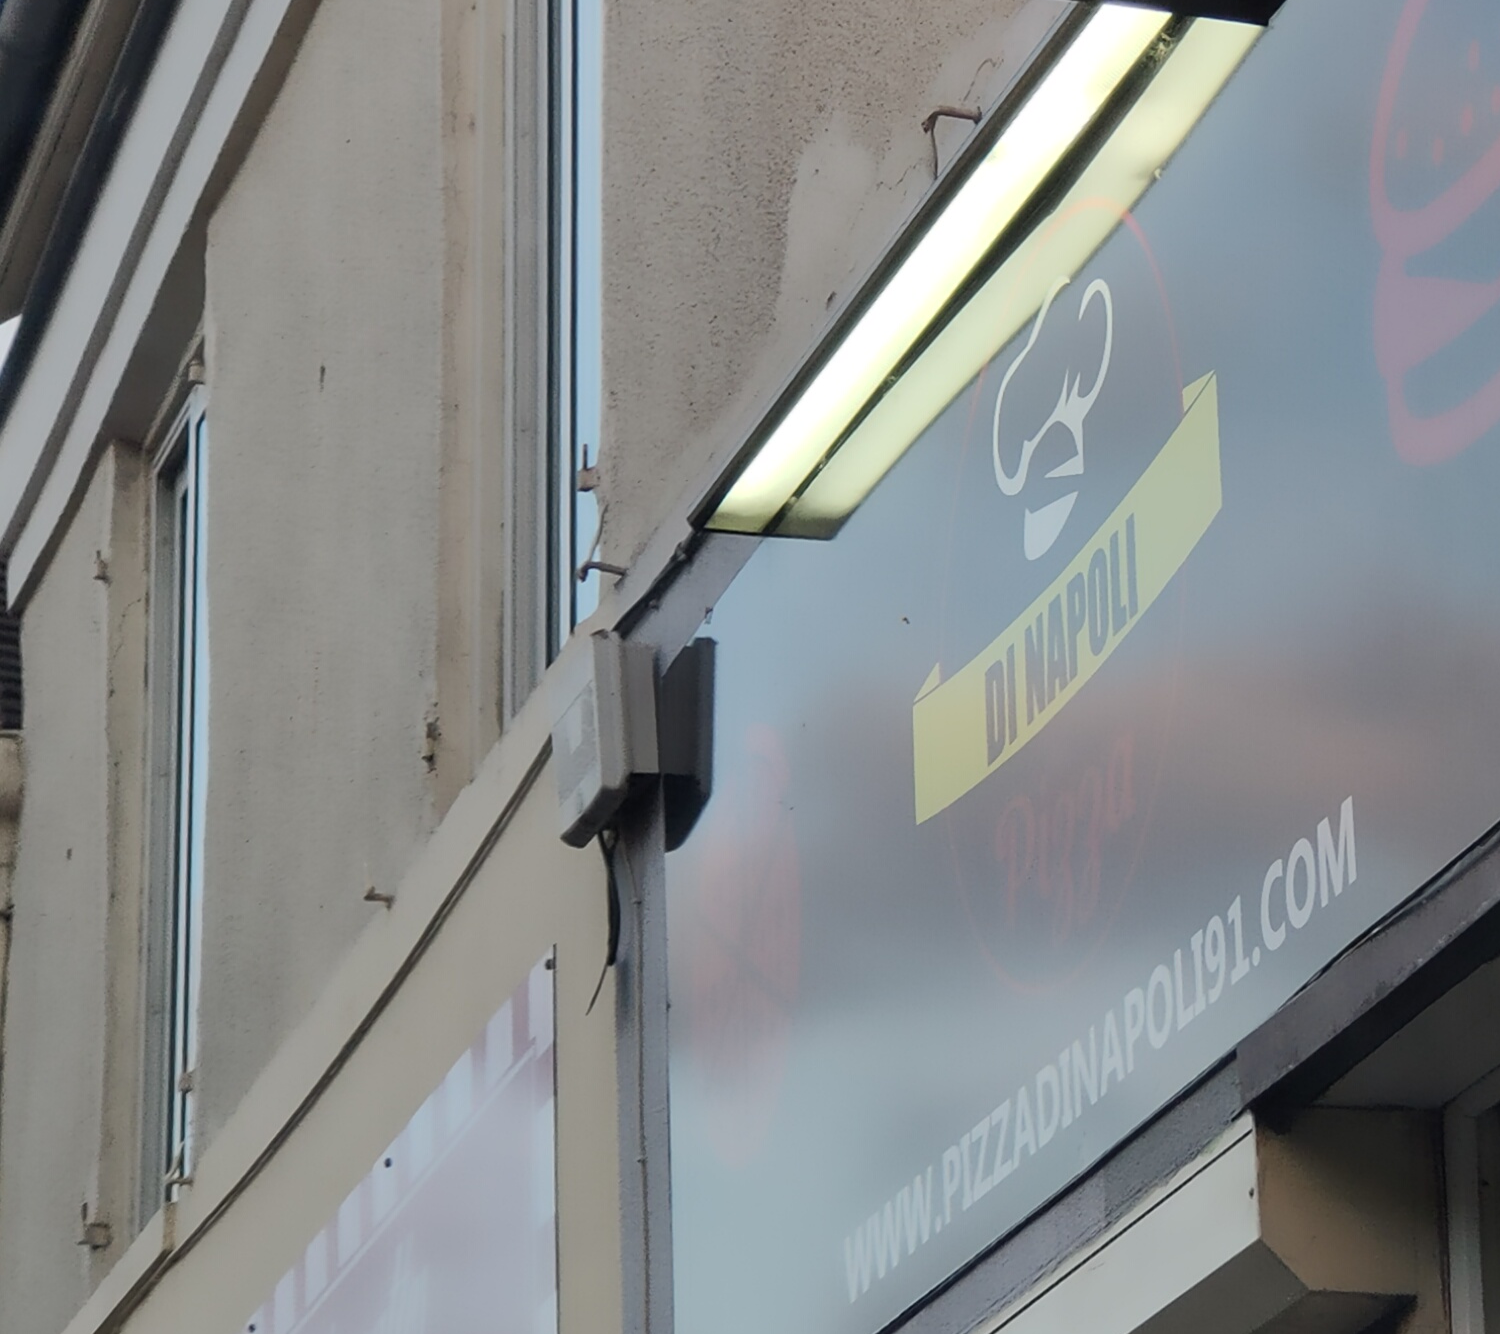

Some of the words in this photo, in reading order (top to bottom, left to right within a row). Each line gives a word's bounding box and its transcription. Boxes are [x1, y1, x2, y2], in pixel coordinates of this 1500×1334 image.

[984, 640, 1018, 768] DI
[1024, 512, 1139, 727] NAPOLI
[842, 795, 1358, 1305] WWW.PIZZADINAPOLI91.COM
